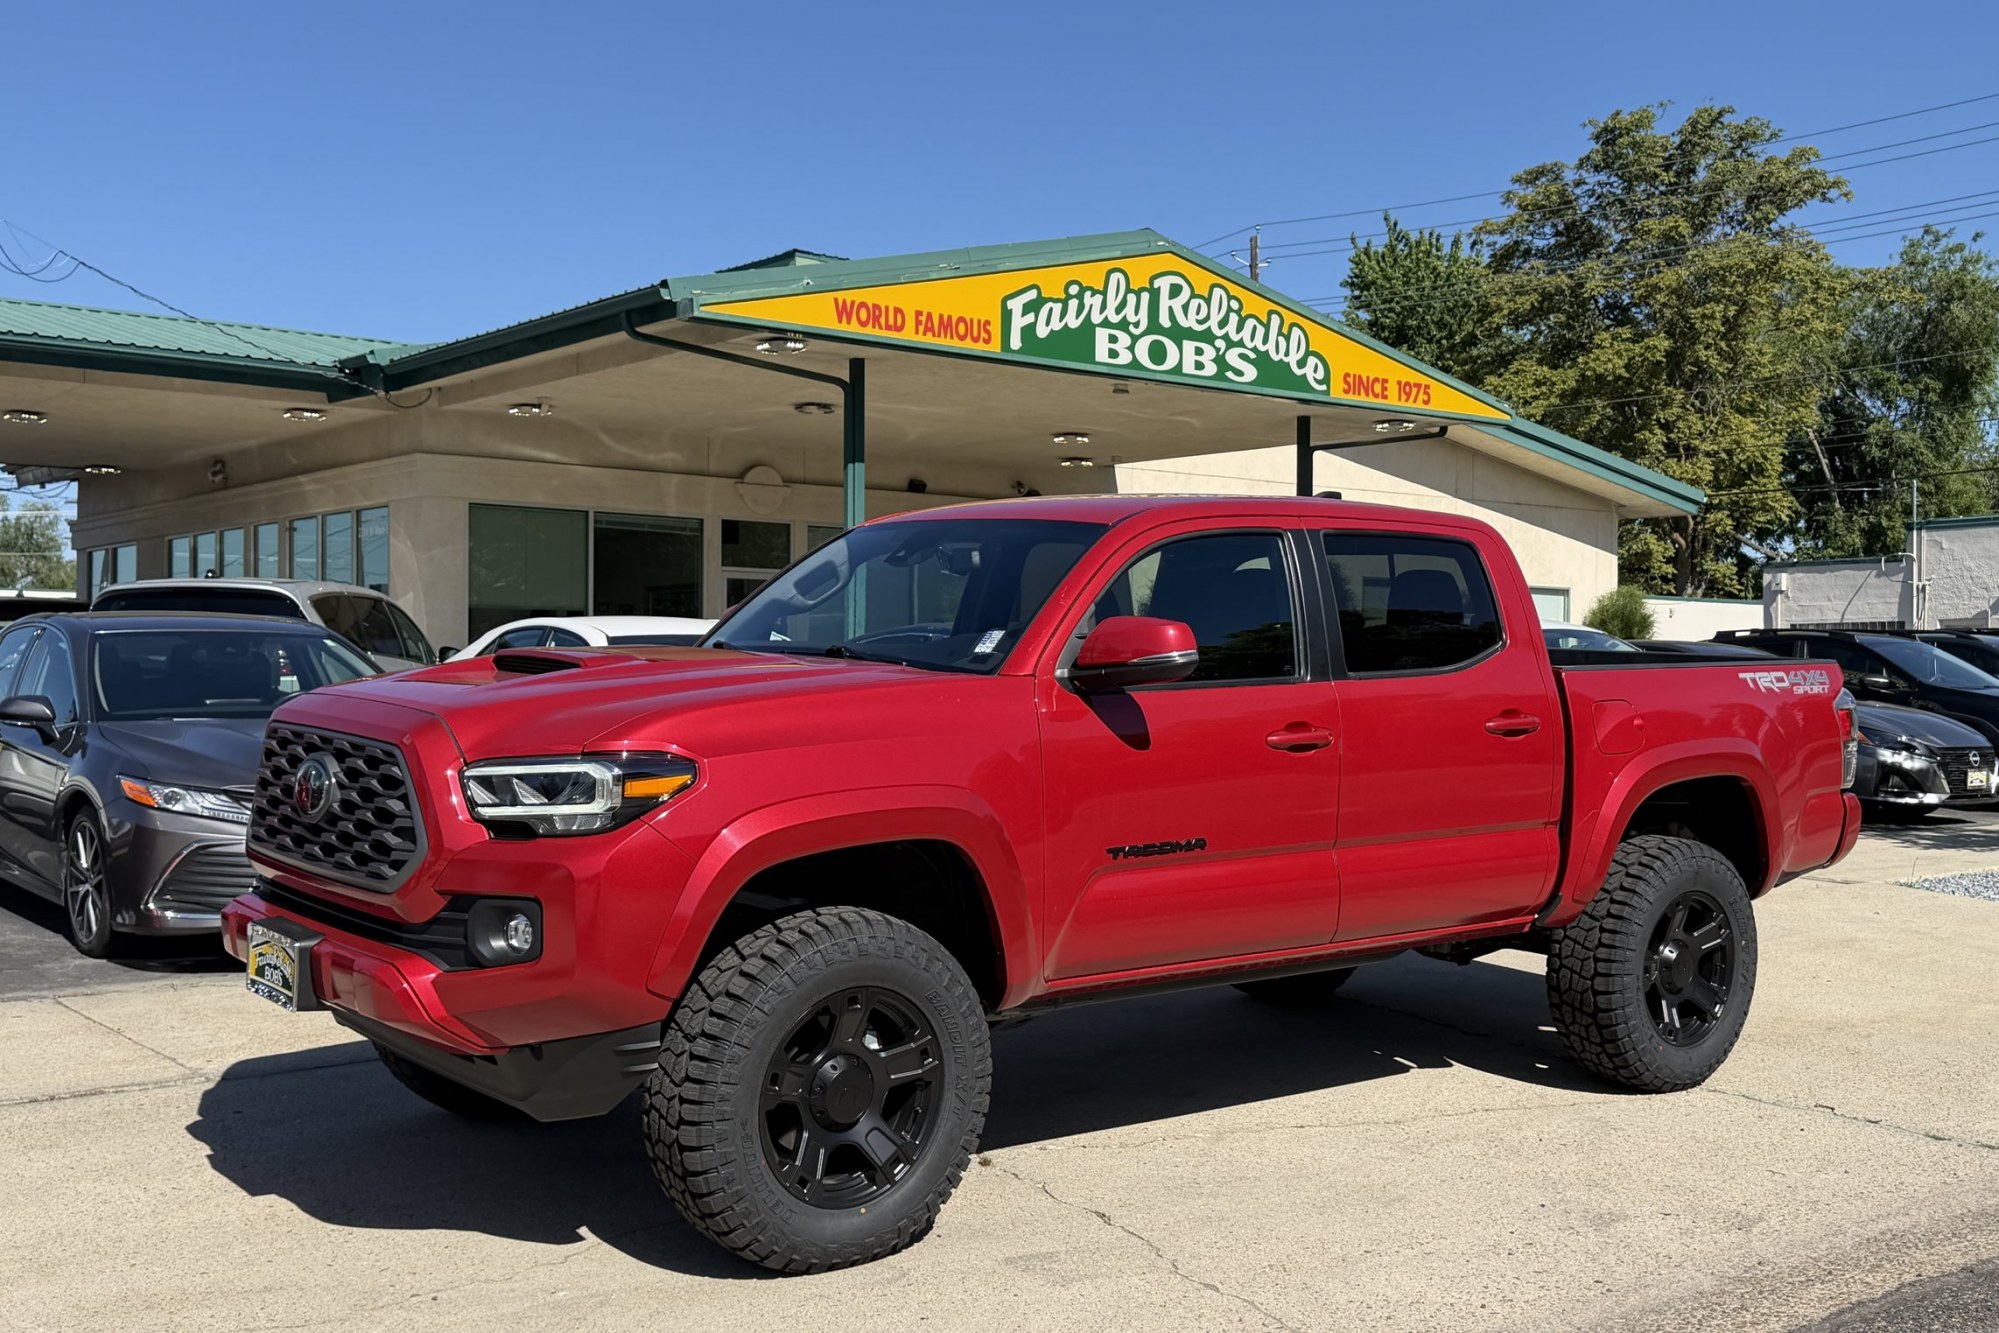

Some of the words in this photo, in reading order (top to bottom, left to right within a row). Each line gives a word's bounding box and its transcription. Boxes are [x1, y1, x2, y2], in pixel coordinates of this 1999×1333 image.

[833, 297, 906, 333] WORLD
[914, 309, 992, 345] FAMOUS
[1007, 272, 1150, 350] Fairly
[1153, 274, 1327, 391] Reliable
[1095, 327, 1257, 382] BOB'S
[1342, 372, 1389, 400] SINCE
[1396, 380, 1431, 406] 1975
[1738, 671, 1791, 694] TRD
[1793, 685, 1830, 694] SPORT
[1105, 838, 1207, 860] TACOMA
[924, 988, 968, 1067] BANDIT
